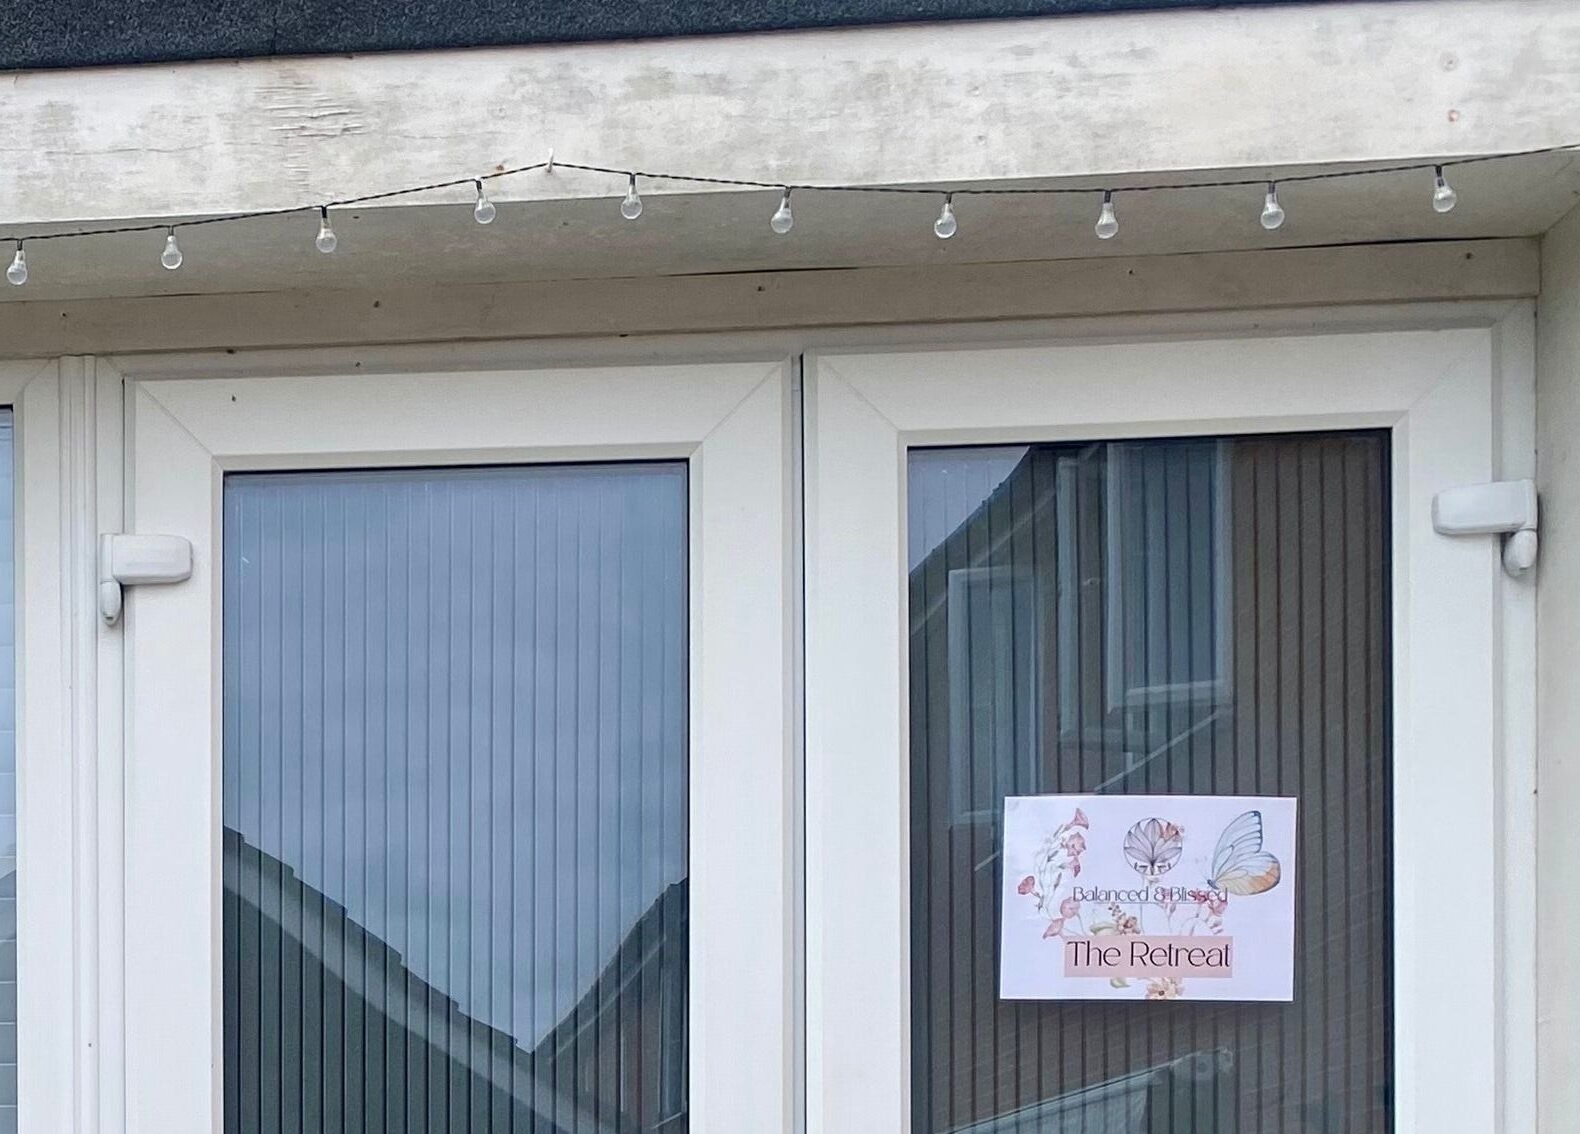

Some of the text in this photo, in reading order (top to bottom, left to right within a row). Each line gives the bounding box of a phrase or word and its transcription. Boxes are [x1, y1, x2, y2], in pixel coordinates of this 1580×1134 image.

[1072, 886, 1229, 902] Balanced & Blissed
[1066, 940, 1231, 968] The Retreat
